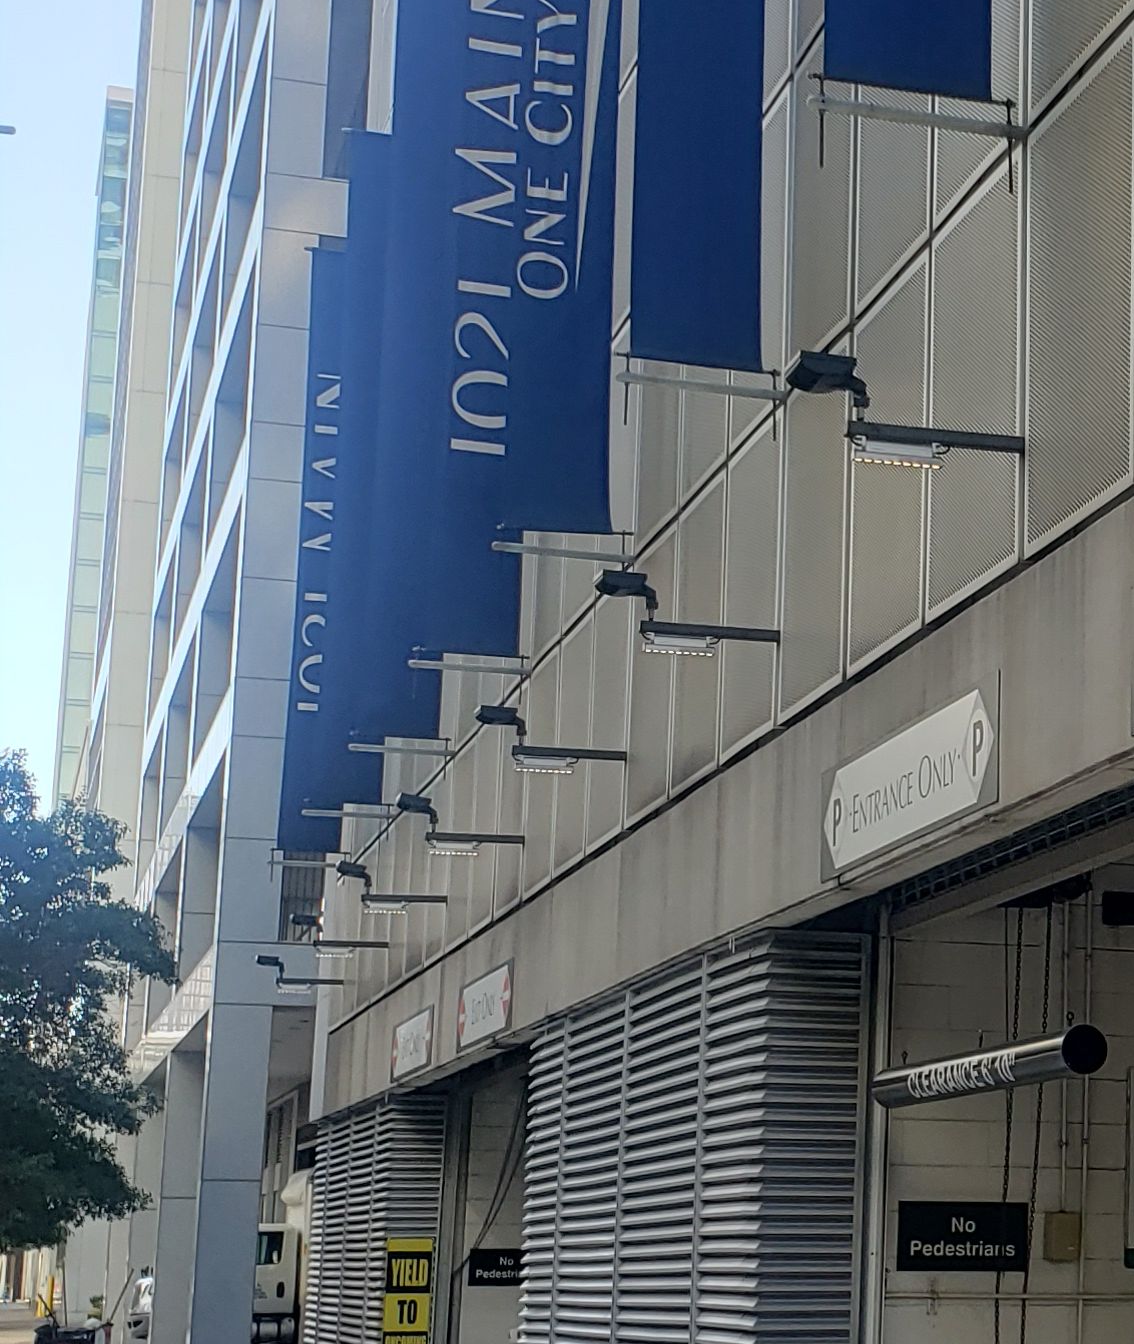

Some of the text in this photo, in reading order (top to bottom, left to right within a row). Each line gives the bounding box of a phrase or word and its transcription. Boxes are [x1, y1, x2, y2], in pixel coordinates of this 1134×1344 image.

[516, 167, 569, 299] ONE
[972, 720, 984, 777] P
[852, 748, 957, 833] ENTRANCE ONLY
[833, 798, 842, 847] P
[907, 1060, 985, 1098] CLEARANCE
[951, 1217, 976, 1233] No
[499, 1257, 514, 1266] No
[910, 1240, 1016, 1257] Pedestrians
[391, 1258, 429, 1287] YIELD
[475, 1269, 519, 1279] Pedestri
[397, 1300, 418, 1324] TO
